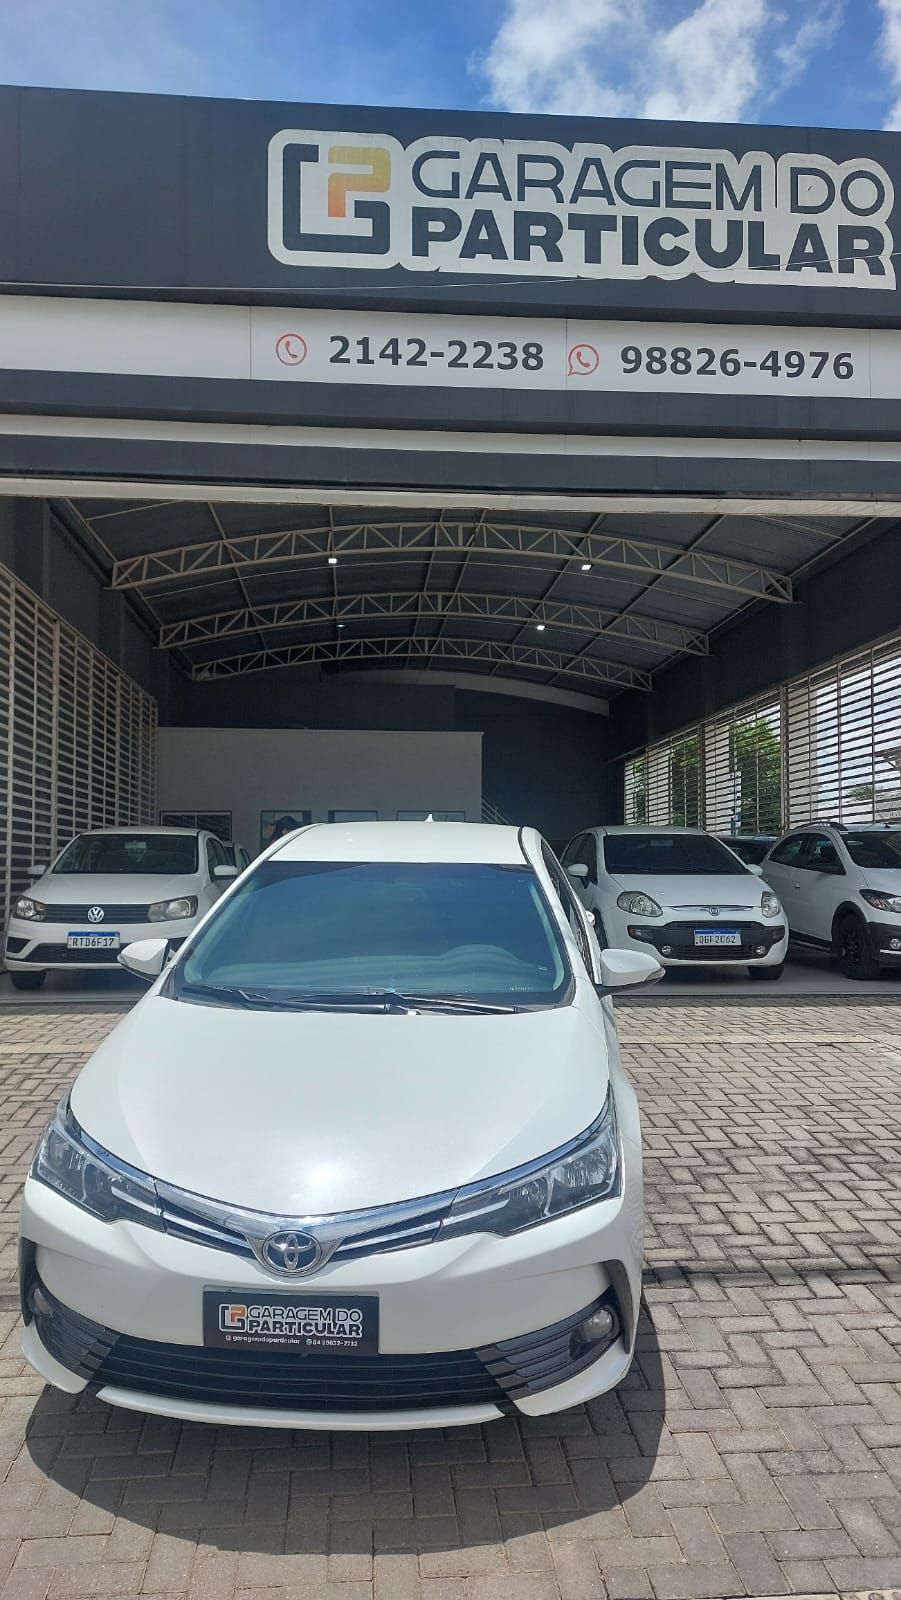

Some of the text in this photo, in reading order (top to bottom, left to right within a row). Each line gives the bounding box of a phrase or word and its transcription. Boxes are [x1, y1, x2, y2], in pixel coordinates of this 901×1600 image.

[411, 149, 885, 217] GARAGEM DO
[411, 206, 886, 276] PARTICULAR
[329, 335, 544, 371] 2142-2238
[621, 346, 854, 380] 98826-4976
[72, 937, 114, 946] RTD6F17
[249, 1307, 361, 1323] GARAGEM DO
[249, 1321, 362, 1336] PARTICULAR
